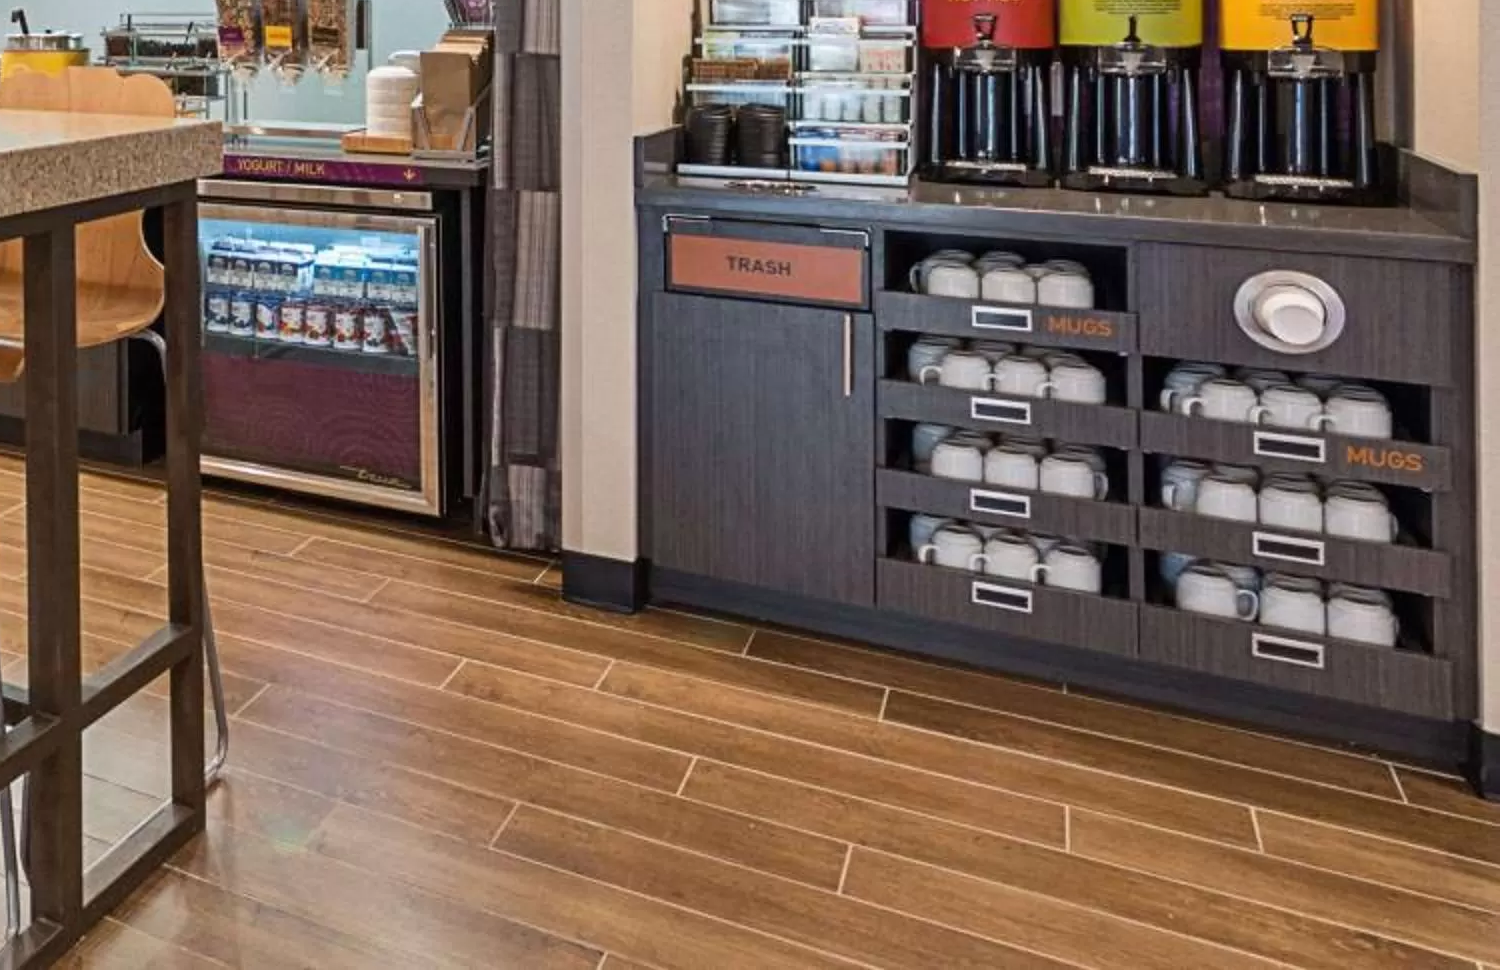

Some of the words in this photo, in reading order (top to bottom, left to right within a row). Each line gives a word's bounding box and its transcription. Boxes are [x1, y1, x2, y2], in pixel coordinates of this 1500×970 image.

[294, 161, 325, 176] MILK
[725, 254, 792, 277] TRASH
[1046, 313, 1113, 338] MUGS
[1346, 444, 1424, 472] MUGS
